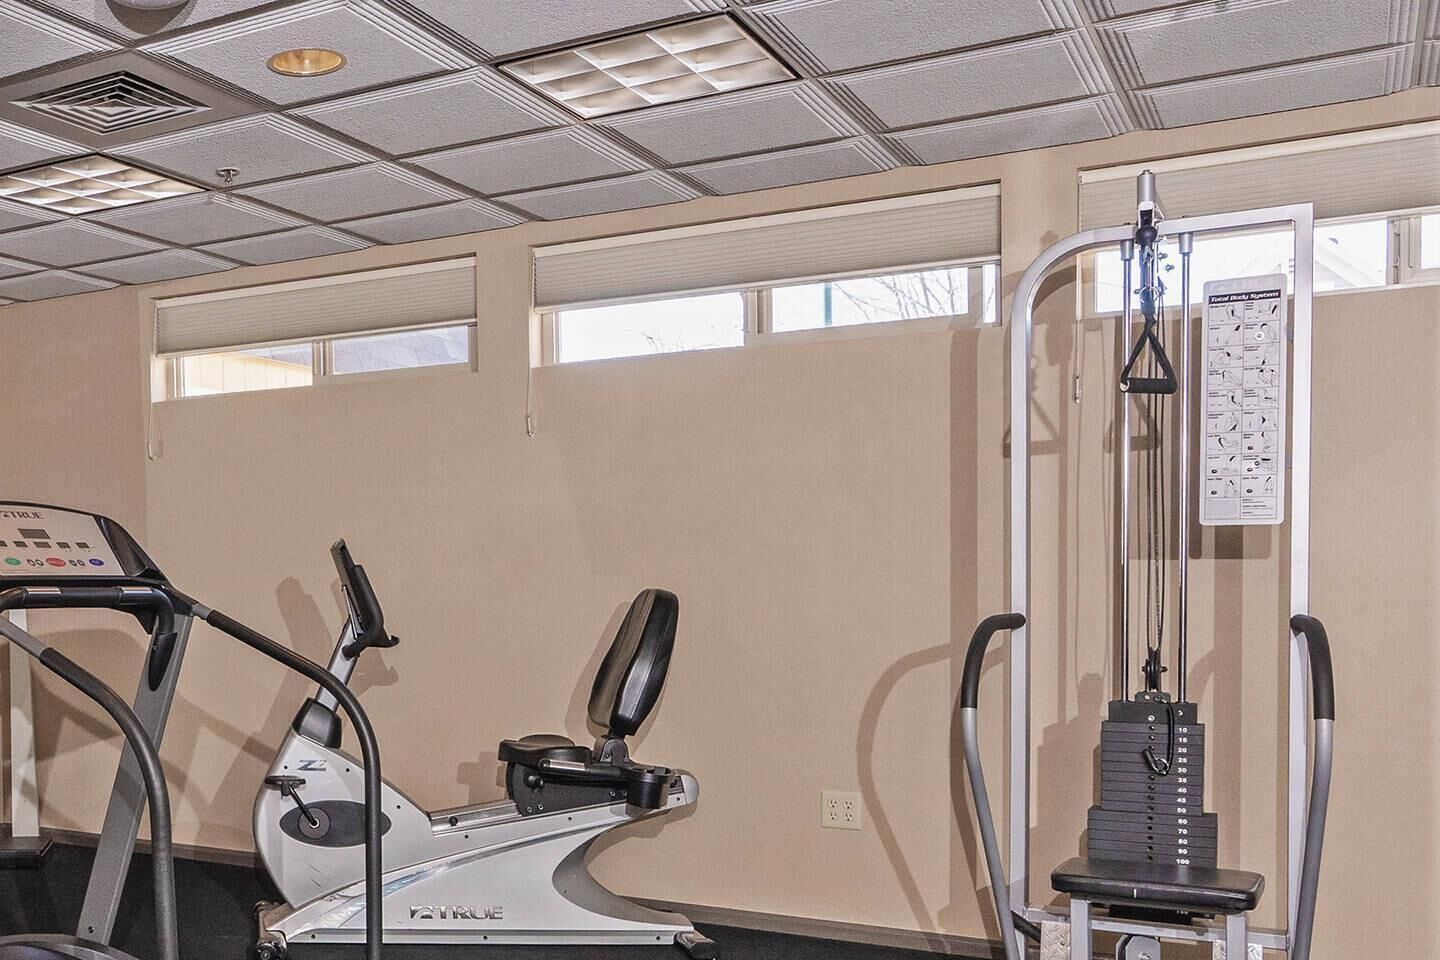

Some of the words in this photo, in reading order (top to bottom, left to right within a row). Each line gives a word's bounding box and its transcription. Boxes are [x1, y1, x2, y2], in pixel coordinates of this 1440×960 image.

[1211, 295, 1230, 303] Total
[1250, 291, 1279, 300] System
[8, 510, 45, 520] TRUE
[434, 905, 504, 920] TRUE
